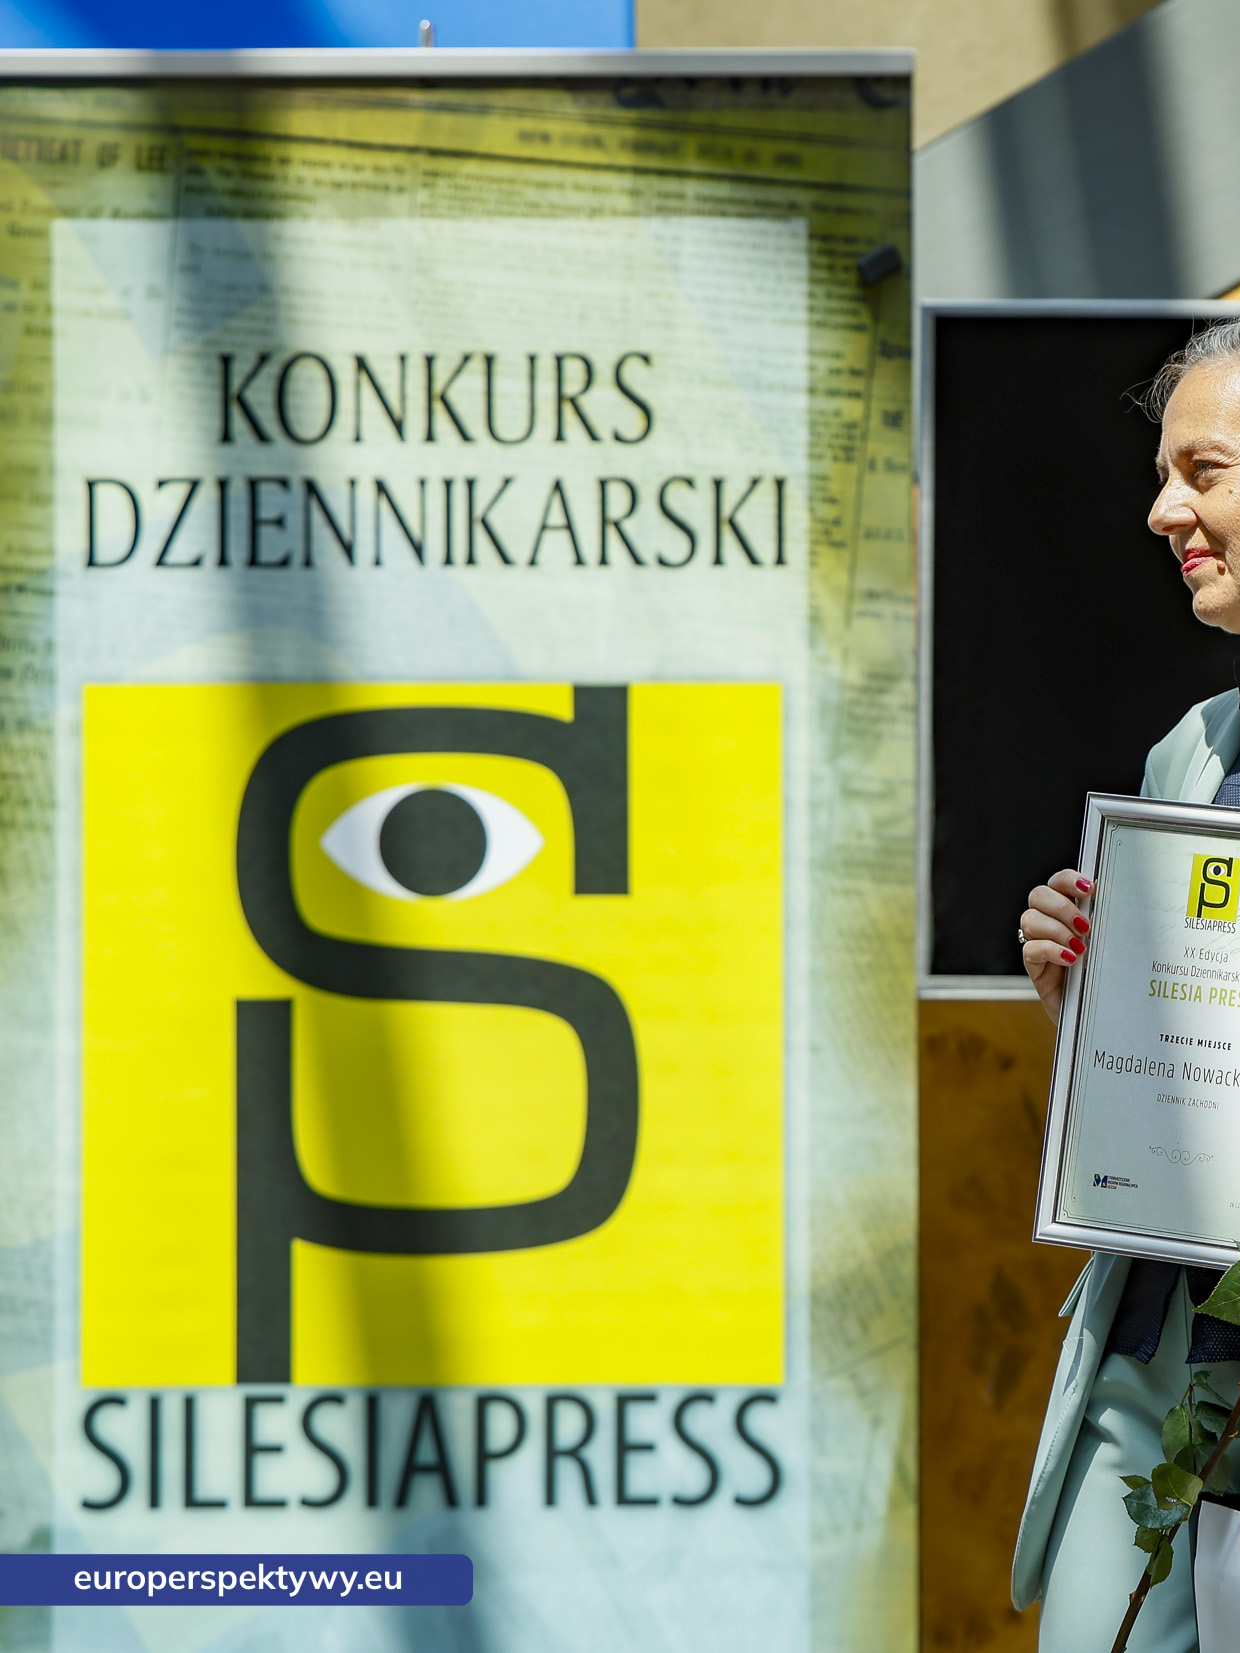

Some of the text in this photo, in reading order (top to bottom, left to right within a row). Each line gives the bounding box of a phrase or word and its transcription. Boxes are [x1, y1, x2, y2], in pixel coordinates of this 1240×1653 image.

[217, 351, 655, 445] KONKURS
[86, 476, 788, 569] DZIENNIKARSKI
[1184, 917, 1237, 934] SILESIAPRESS
[1183, 946, 1229, 964] XX Edycja
[1151, 960, 1189, 976] Konkursu
[1148, 979, 1202, 1003] SILESIA
[1159, 1033, 1232, 1051] TRZECIE MIEJSCE
[1093, 1049, 1175, 1079] Magdalena
[1156, 1093, 1220, 1110] DZIENNIK ZACHODNI
[80, 1393, 783, 1510] SILESIAPRESS
